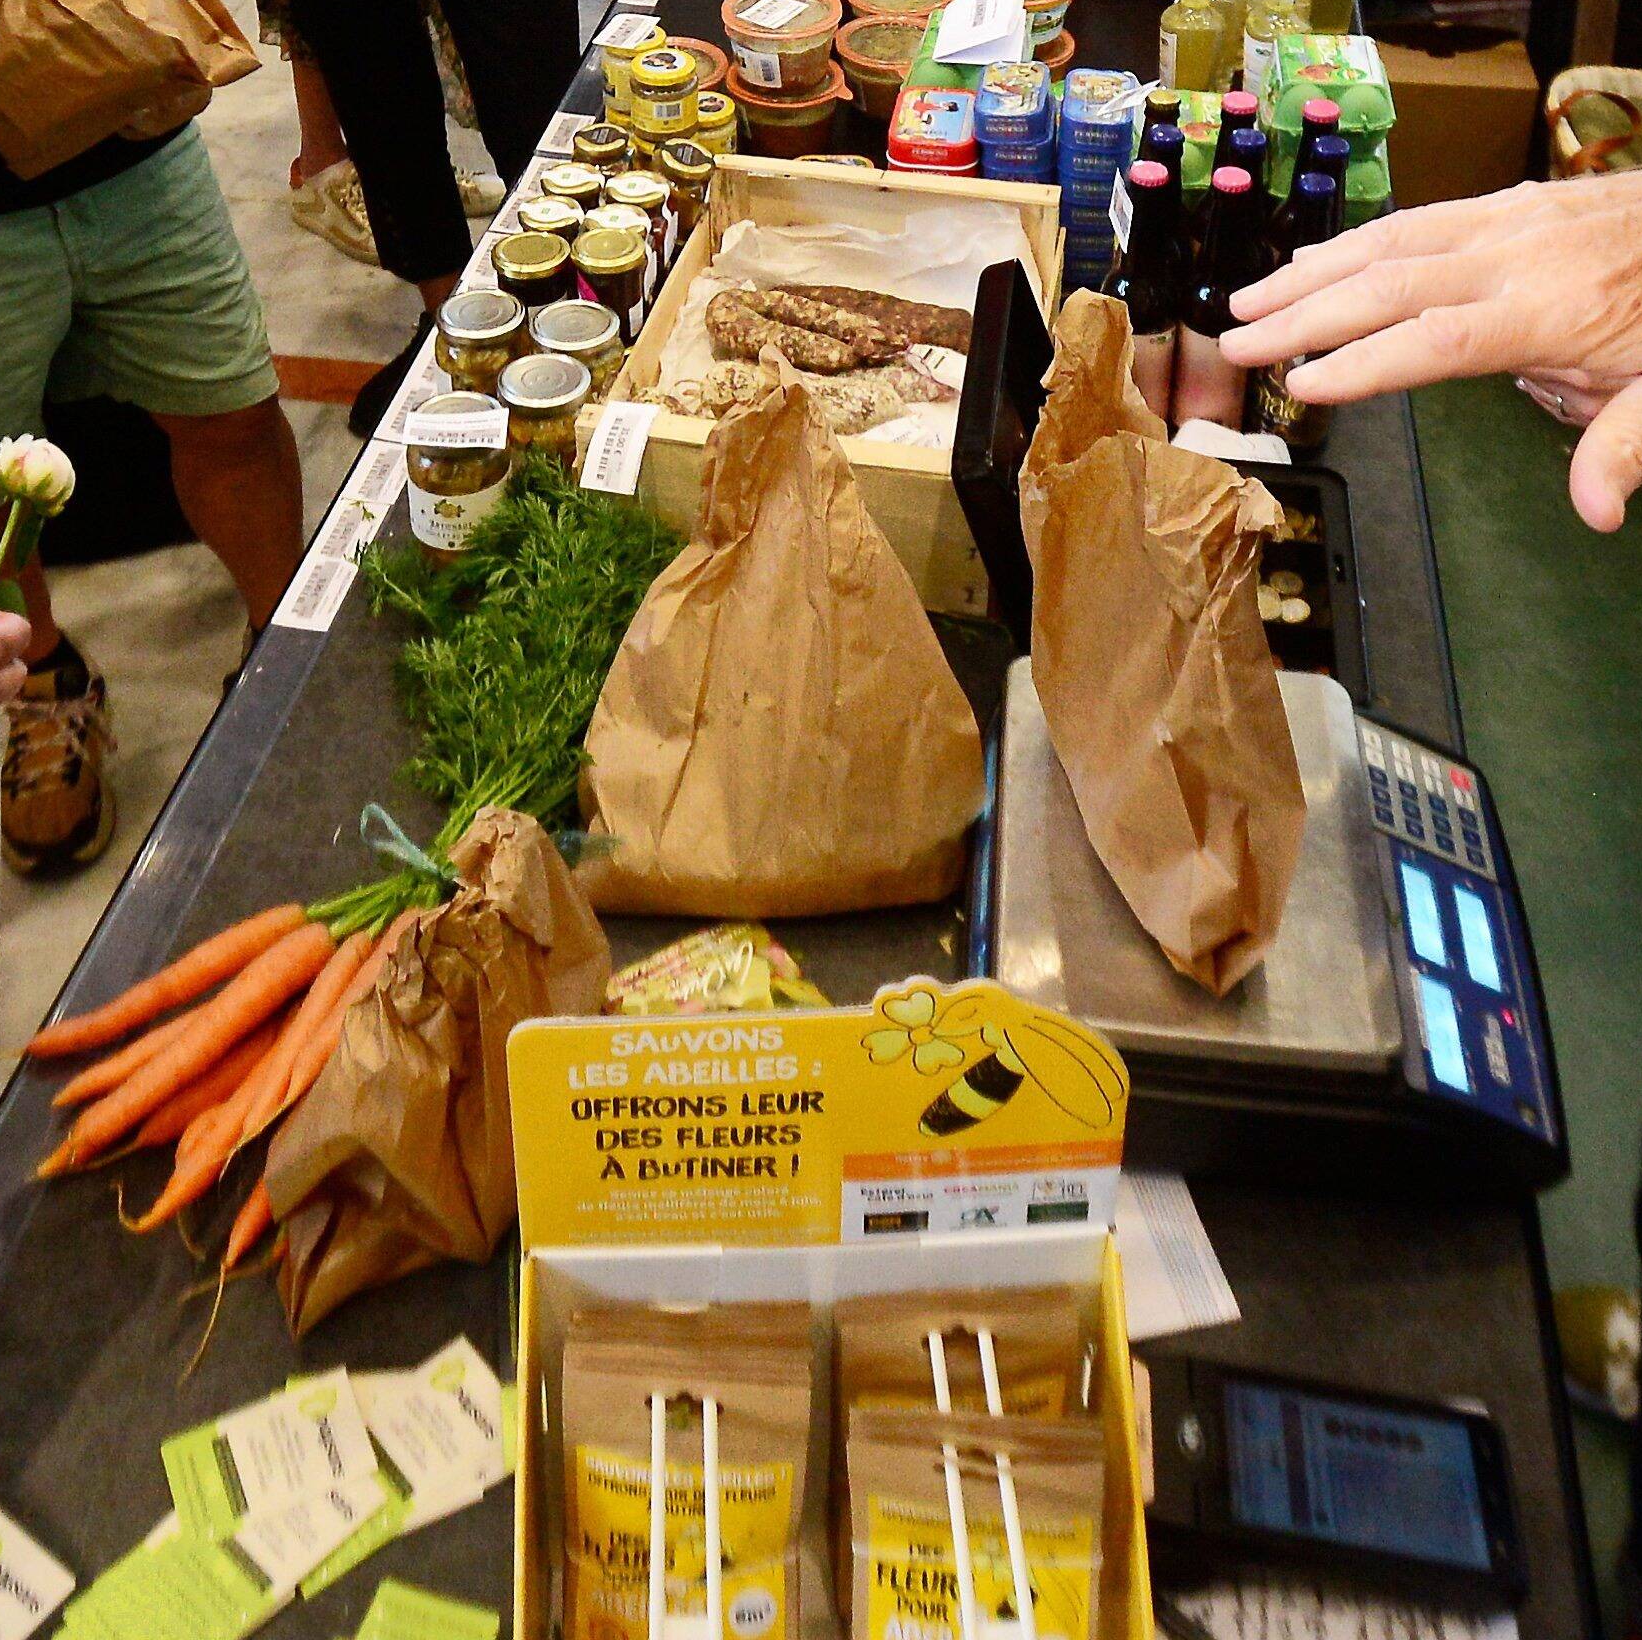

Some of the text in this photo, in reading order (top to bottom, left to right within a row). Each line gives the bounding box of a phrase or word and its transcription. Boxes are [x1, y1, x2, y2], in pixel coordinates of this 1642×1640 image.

[568, 1063, 629, 1089] LES
[570, 1091, 825, 1121] OFFRONS LEUR
[595, 1124, 802, 1152] DES FLEURS
